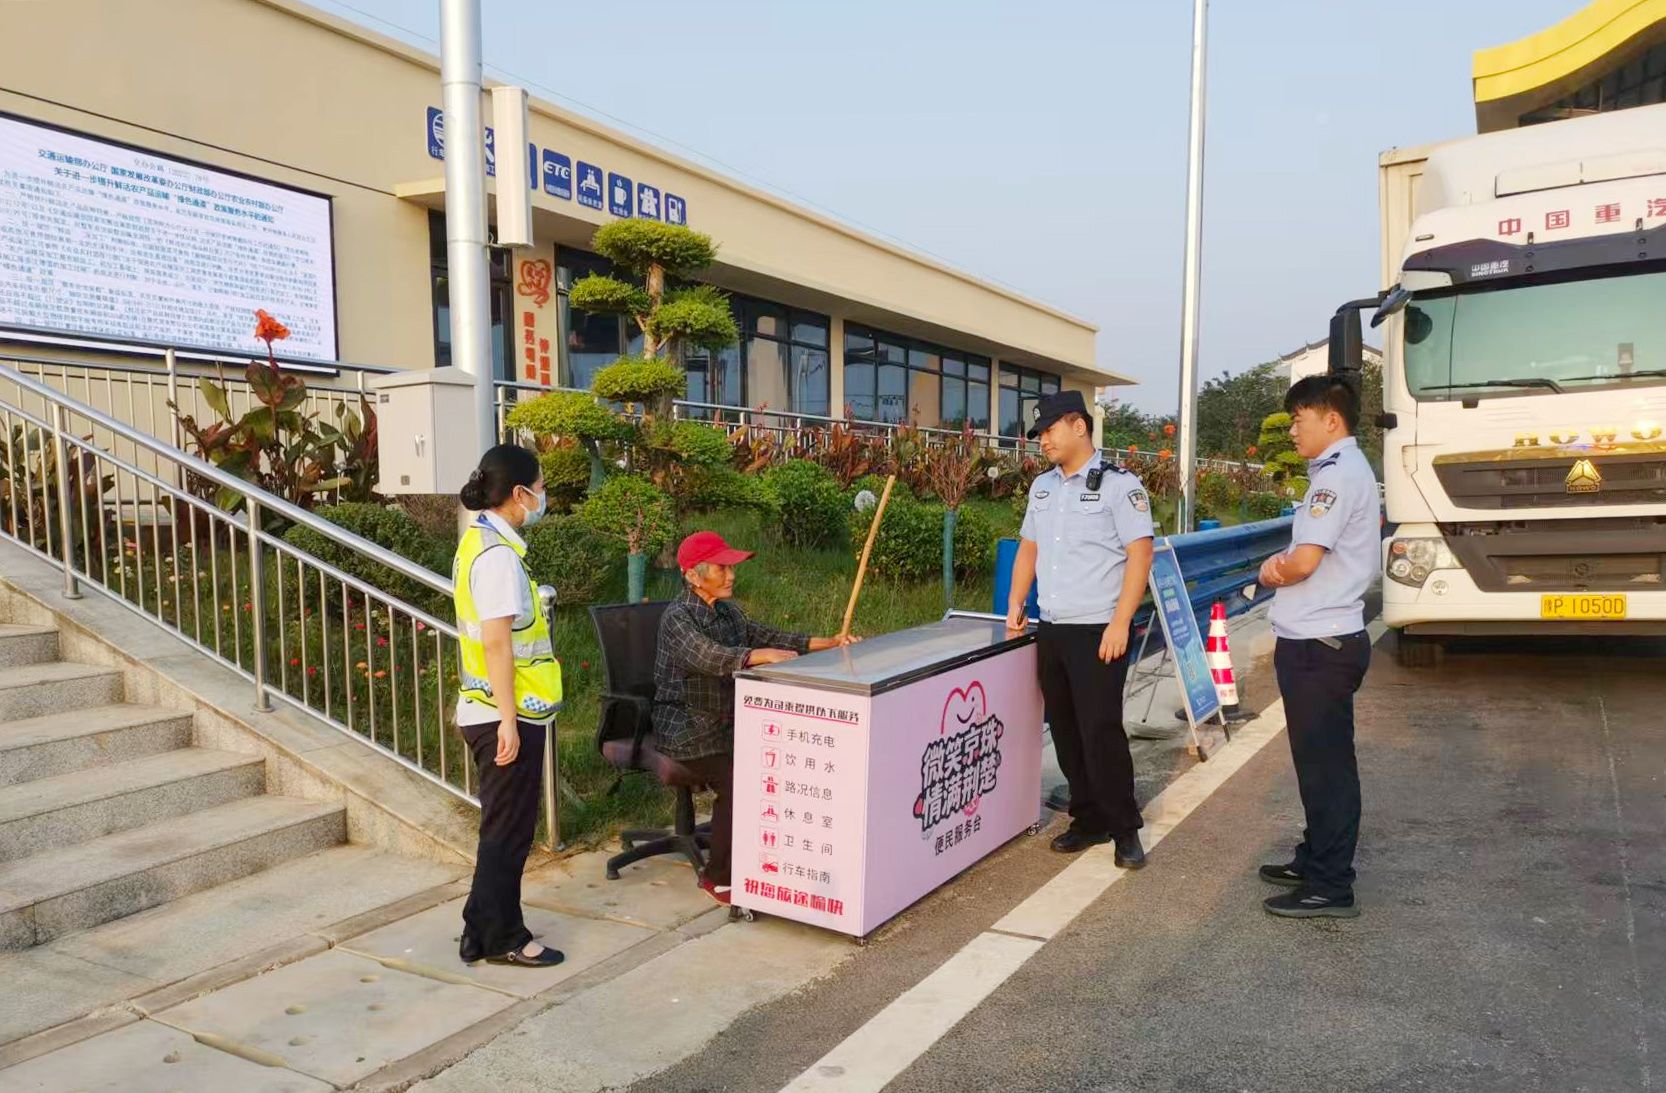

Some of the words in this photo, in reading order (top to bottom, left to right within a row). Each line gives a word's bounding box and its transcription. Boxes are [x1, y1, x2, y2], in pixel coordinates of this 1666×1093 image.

[543, 160, 571, 179] ETC
[1498, 198, 1666, 236] 中国重汽
[787, 729, 835, 748] 手机充电
[784, 780, 833, 801] 路况信息
[934, 815, 982, 856] 便民服务台
[782, 862, 831, 885] 行车指南
[743, 877, 844, 917] 祝您旅途愉快
